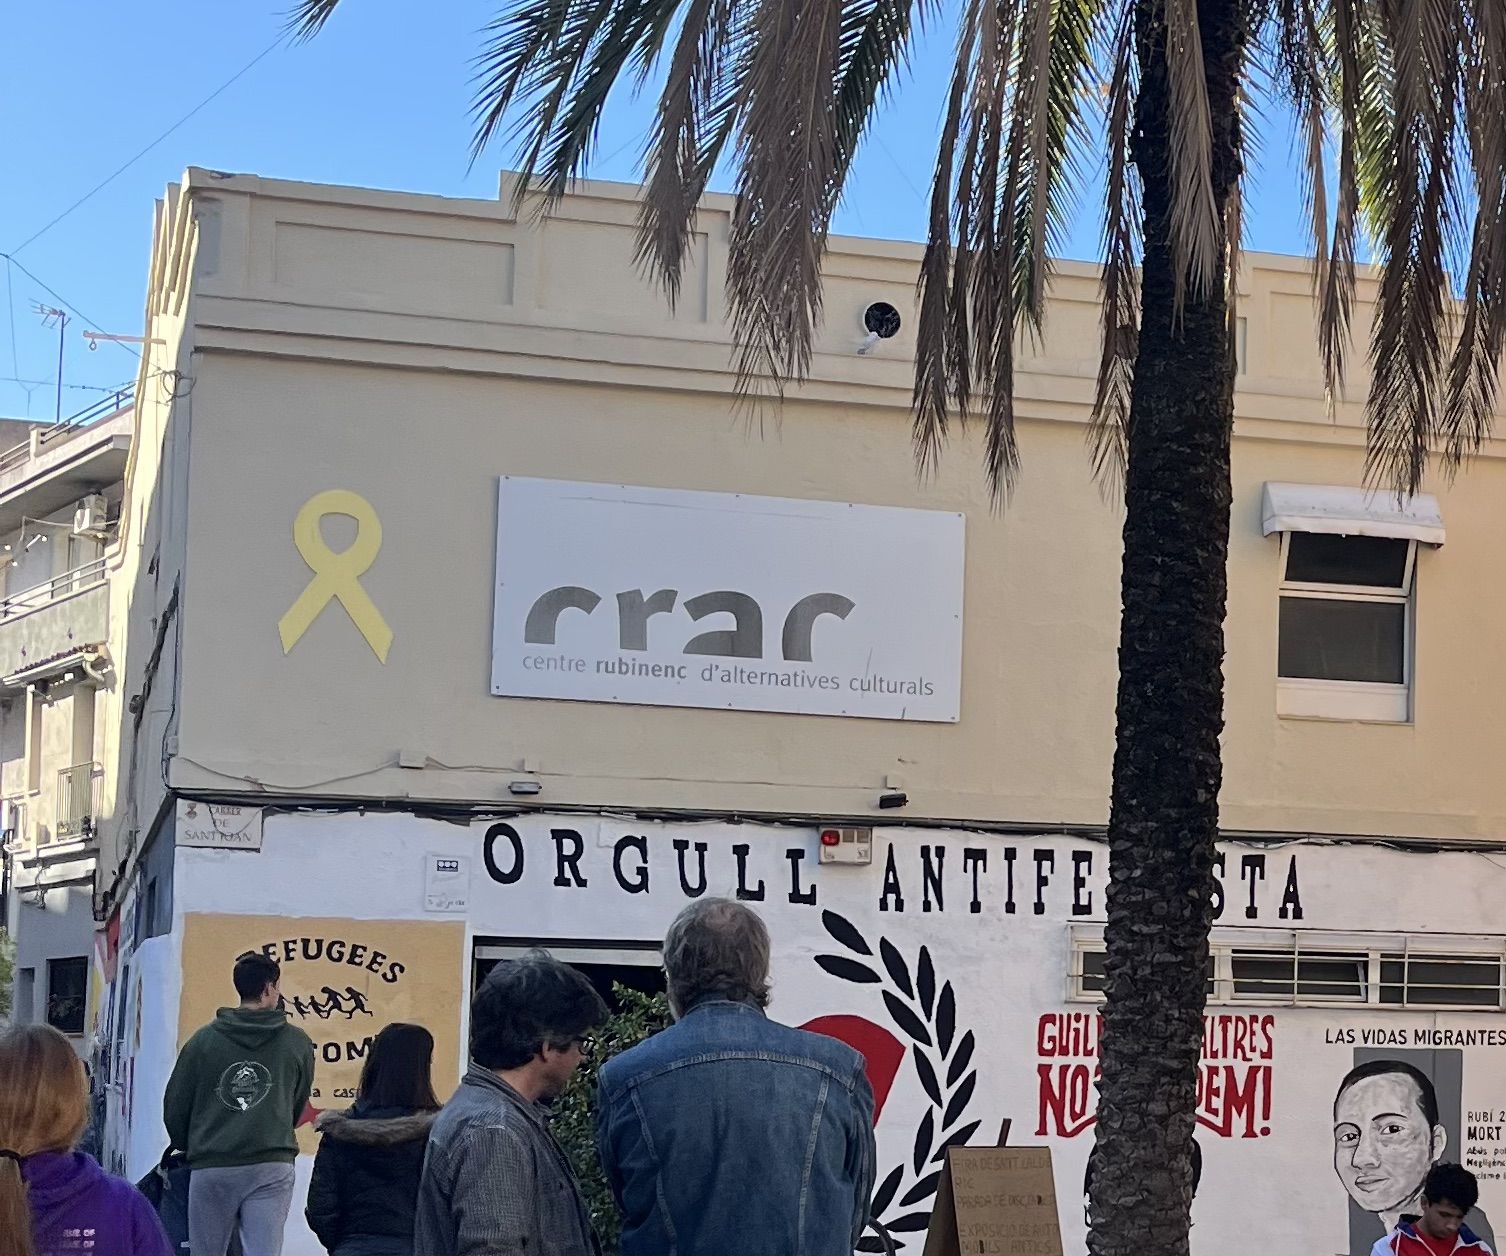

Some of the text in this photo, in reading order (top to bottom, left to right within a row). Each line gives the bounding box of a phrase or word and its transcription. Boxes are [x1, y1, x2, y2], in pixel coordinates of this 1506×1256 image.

[522, 653, 935, 697] centre rubinenc d'alternatives culturals
[184, 830, 217, 841] SANT
[483, 822, 1303, 920] ORGULL ANTIFESTA
[1325, 1028, 1355, 1045] LAS
[1361, 1028, 1407, 1045] VIDAS
[1413, 1028, 1506, 1046] MIGRANTES
[1467, 1126, 1502, 1141] MORT
[1474, 1172, 1501, 1180] cisme
